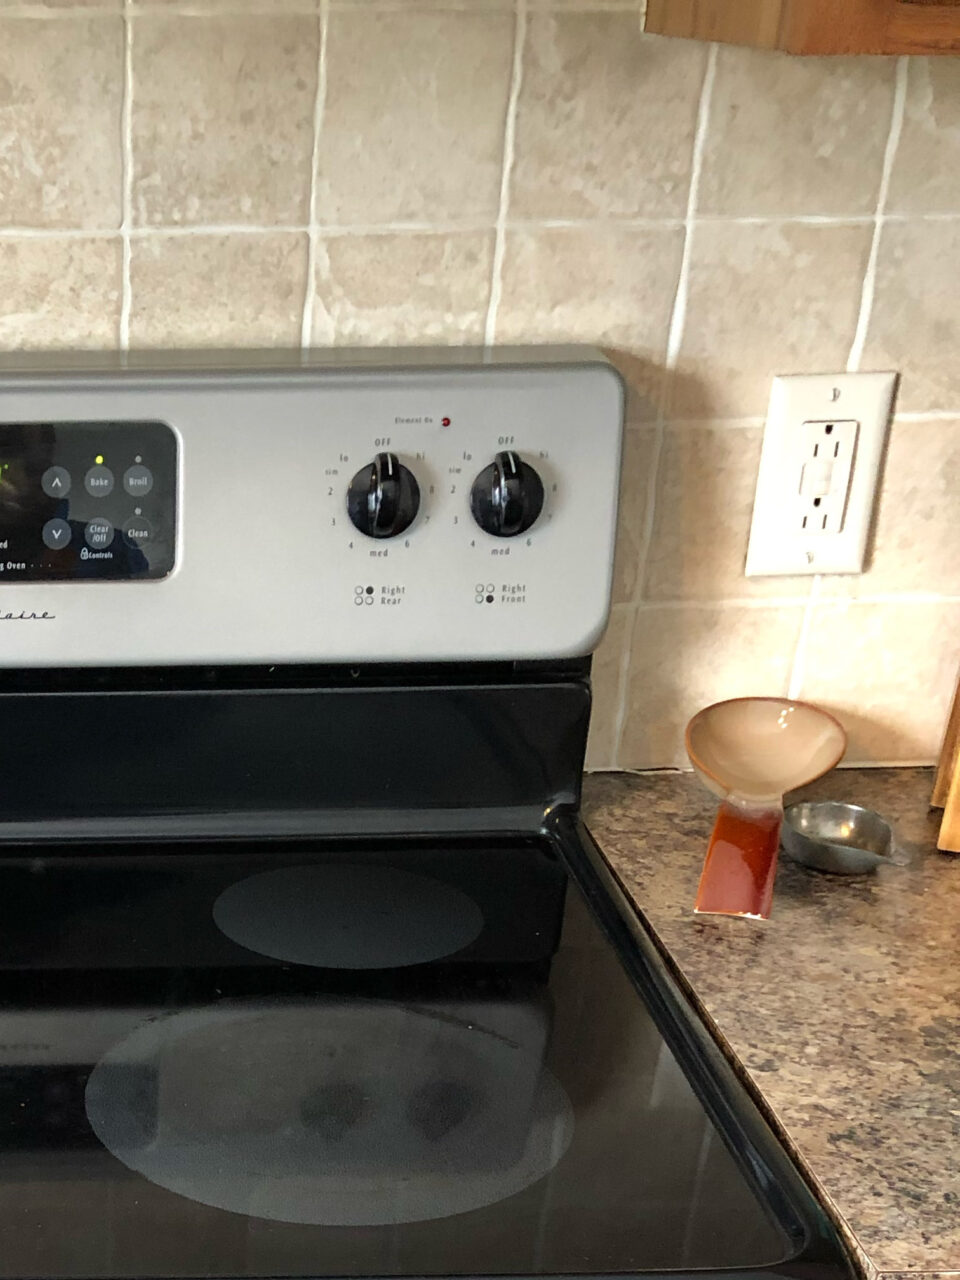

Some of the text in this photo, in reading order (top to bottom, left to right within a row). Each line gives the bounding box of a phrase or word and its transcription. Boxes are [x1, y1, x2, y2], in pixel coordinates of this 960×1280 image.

[375, 438, 391, 447] OFF
[498, 436, 514, 445] OFF
[90, 478, 108, 486] Bake
[129, 477, 148, 486] Broil
[89, 525, 109, 533] Clear
[128, 529, 148, 538] Clean
[92, 533, 107, 542] /Off
[369, 549, 388, 557] med
[491, 546, 510, 555] med
[6, 560, 26, 569] Oven
[381, 586, 405, 596] Right
[502, 584, 526, 594] Right
[380, 597, 401, 605] Rear
[501, 595, 526, 603] Front
